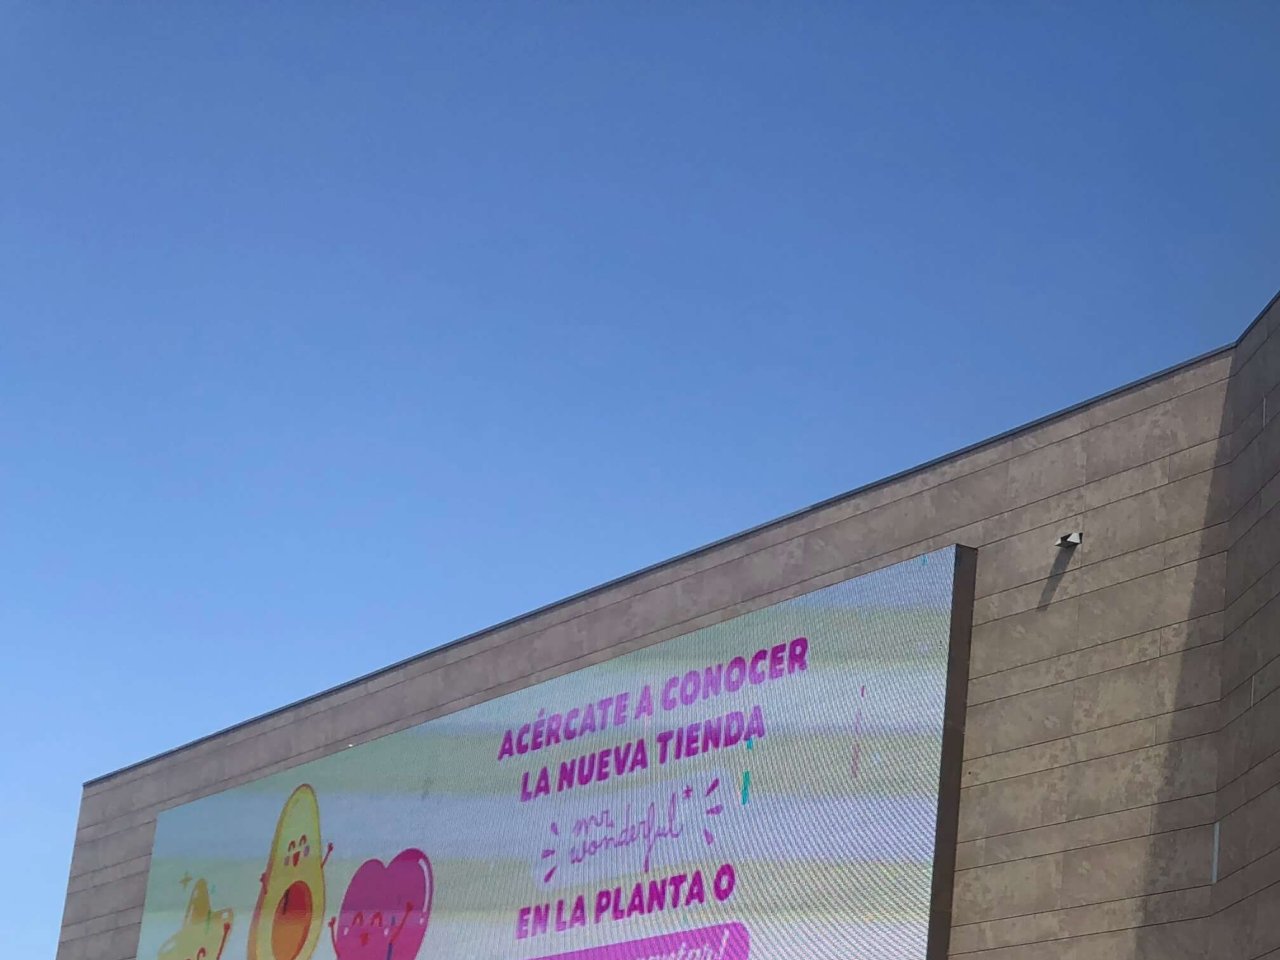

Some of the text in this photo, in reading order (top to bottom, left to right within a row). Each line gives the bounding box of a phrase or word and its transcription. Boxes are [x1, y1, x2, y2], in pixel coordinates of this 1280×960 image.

[497, 636, 809, 761] ACÉRCATE A CONOCER
[520, 705, 766, 801] LA NUEVA TIENDA
[515, 902, 549, 939] EN
[555, 895, 586, 932] LA
[594, 869, 705, 925] PLANTA
